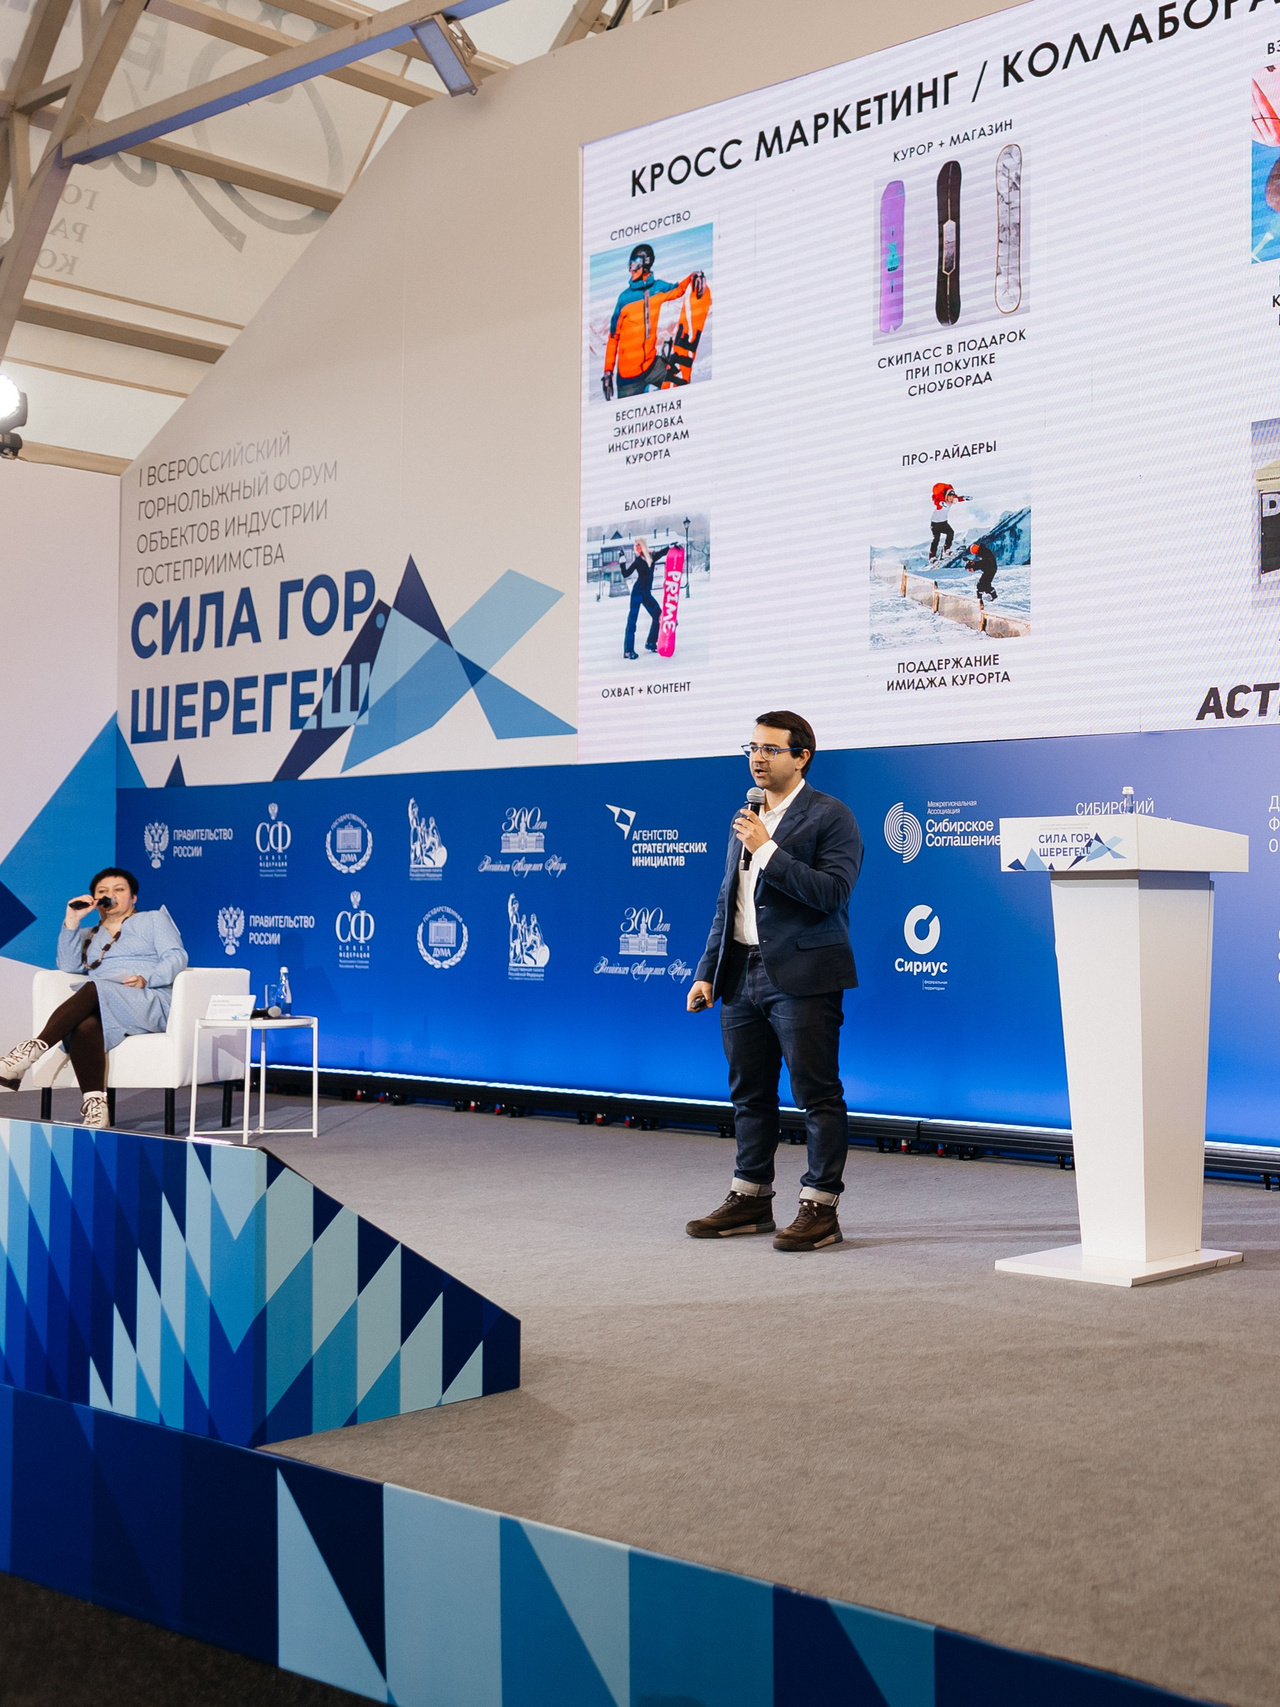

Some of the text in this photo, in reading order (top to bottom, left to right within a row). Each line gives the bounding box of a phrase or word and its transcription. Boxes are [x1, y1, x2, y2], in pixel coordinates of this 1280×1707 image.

[630, 139, 743, 197] КРОСС
[754, 71, 959, 162] МАРКЕТИНГ
[971, 60, 988, 102] /
[892, 141, 934, 163] КУРОР
[950, 119, 1014, 148] МАГАЗИН
[609, 210, 692, 242] СПОНСОРСТВО
[877, 328, 1027, 369] СКИПАСС В ПОДАРОК
[905, 353, 996, 380] ПРИ ПОКУПКЕ
[907, 371, 993, 397] СНОУБОРДА
[615, 399, 682, 422] БЕСПЛАТНАЯ
[613, 415, 684, 438] ЭКИПИРОВКА
[608, 429, 690, 453] ИНСТРУКТОРАМ
[147, 430, 290, 486] ВСЕРОССИЙСКИЙ
[625, 448, 671, 465] КУРОРТА
[902, 440, 997, 466] ПРО-РАЙДЕРЫ
[138, 460, 338, 520] ГОРНОЛЫЖНЫЙ ФОРУМ
[624, 495, 671, 511] БЛОГЕРЫ
[136, 499, 328, 554] ОБЪЕКТОВ ИНДУСТРИИ
[136, 543, 285, 588] ГОСТЕПРИИМСТВА
[131, 586, 261, 659] СИЛА
[897, 654, 1000, 674] ПОДДЕРЖАНИЕ
[601, 686, 635, 698] ОХВАТ
[646, 682, 691, 695] КОНТЕНТ
[886, 671, 1011, 691] ИМИДЖА КУРОРТА
[130, 662, 371, 744] ШЕРЕГЕШ
[173, 828, 233, 841] ПРАВИТЕЛЬСТВО
[255, 821, 291, 853] СФ
[632, 829, 679, 841] АГЕНТСТВО
[925, 818, 994, 835] Сибирское
[631, 842, 708, 854] СТРАТЕГИЧЕСКИХ
[925, 833, 1001, 847] Соглашение
[1038, 834, 1068, 843] СИЛА
[173, 846, 202, 858] РОССИИ
[632, 855, 686, 868] ИНИЦИАТИВ
[249, 915, 315, 928] ПРАВИТЕЛЬСТВО
[335, 910, 375, 943] СФ
[249, 932, 280, 945] РОССИИ
[894, 957, 948, 976] Сириус
